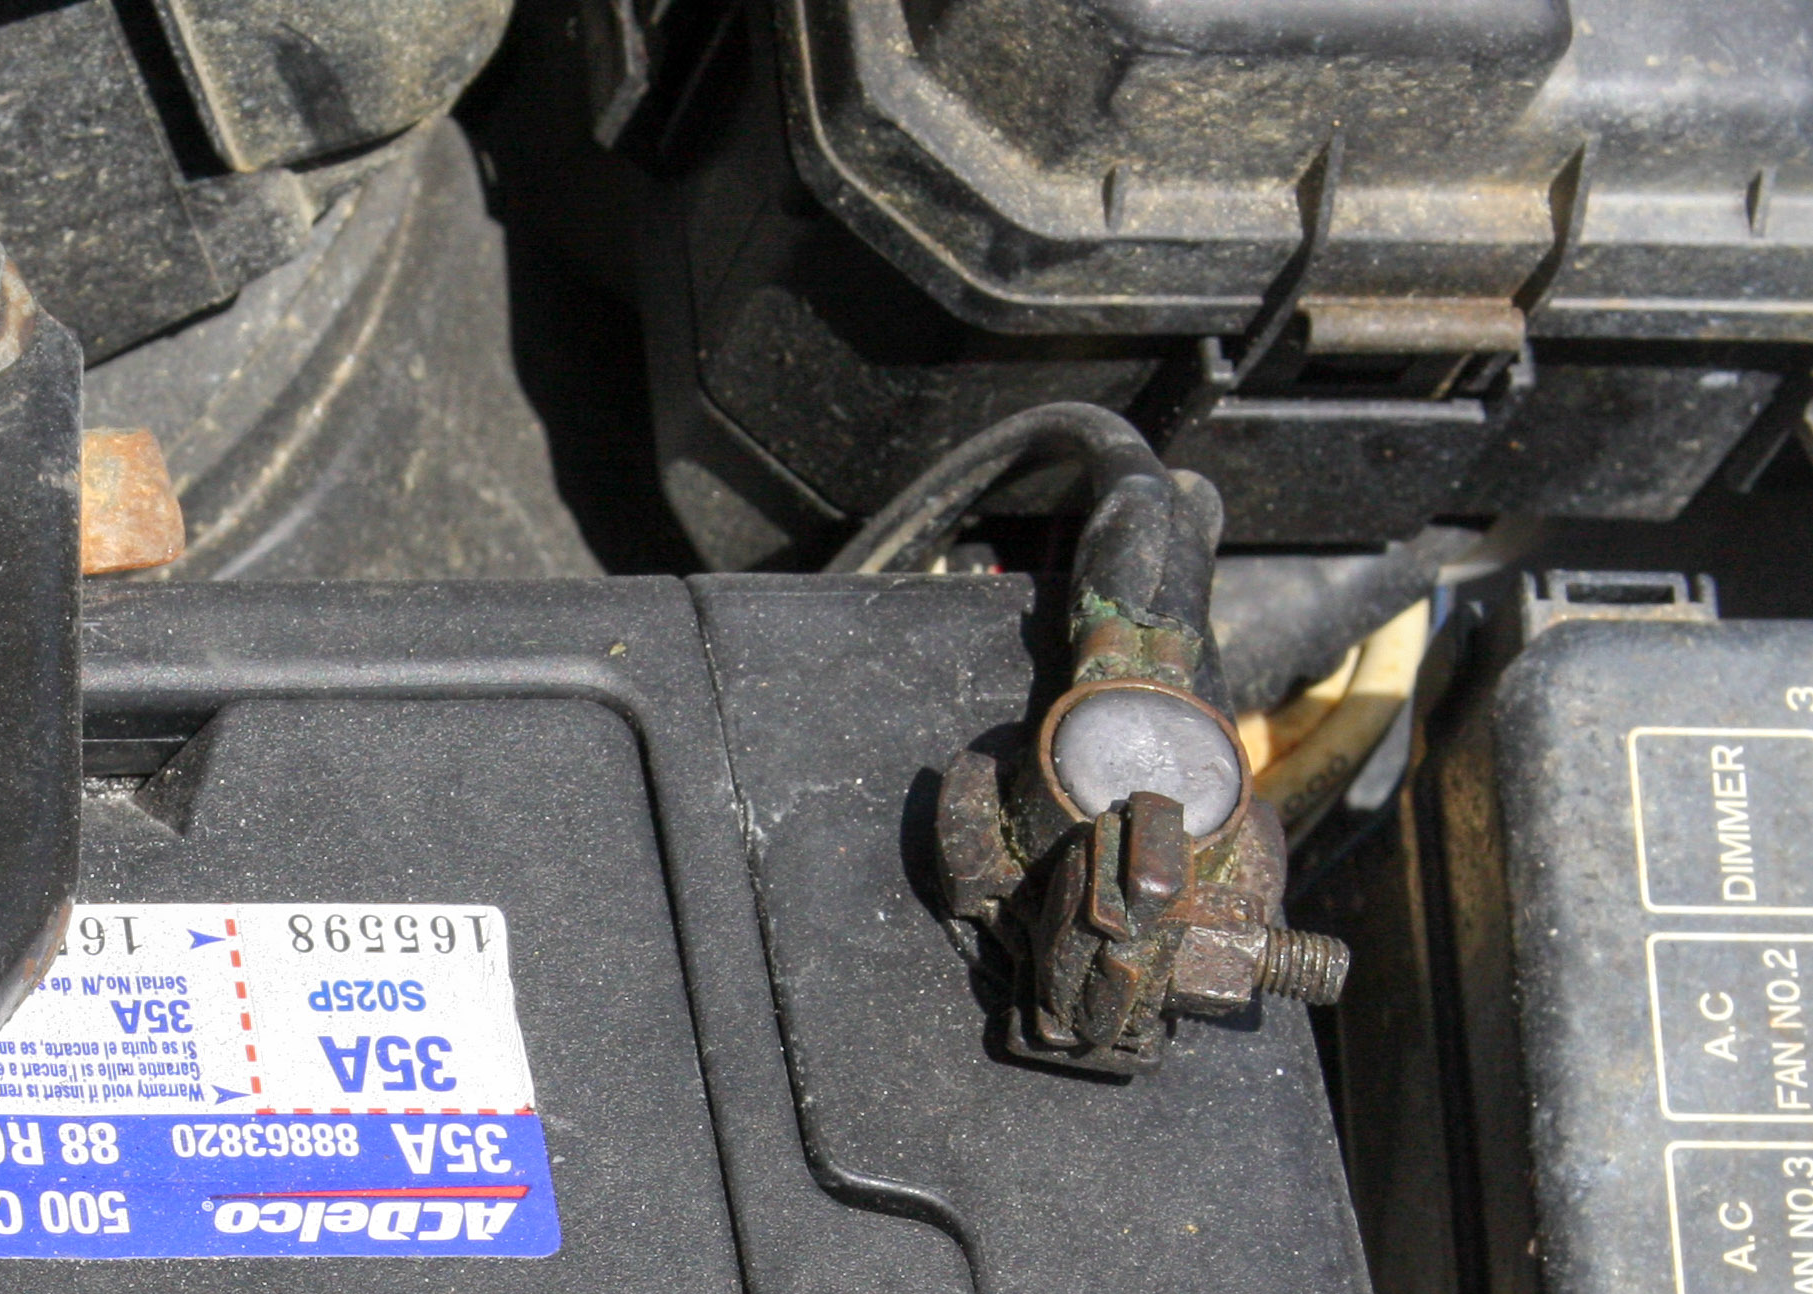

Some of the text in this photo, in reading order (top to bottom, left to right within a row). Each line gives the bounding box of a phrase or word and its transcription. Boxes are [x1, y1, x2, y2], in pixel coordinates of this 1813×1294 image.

[1711, 744, 1757, 901] DIMMER
[288, 914, 492, 953] 165598
[51, 977, 71, 994] de
[135, 976, 187, 995] Serial
[308, 980, 426, 1012] S025P
[111, 999, 193, 1034] 35A
[1699, 991, 1738, 1062] A.C
[1762, 948, 1812, 1109] FAN NO.2
[20, 1042, 36, 1056] se
[40, 1040, 100, 1058] encarte,
[104, 1042, 117, 1059] el
[122, 1037, 157, 1058] quita
[162, 1041, 178, 1055] se
[181, 1041, 197, 1058] Si
[10, 1062, 17, 1075] a
[22, 1062, 77, 1080] l'encart
[81, 1062, 93, 1080] si
[98, 1062, 134, 1080] nulle
[139, 1062, 200, 1079] Garantie
[318, 1036, 457, 1092] 35A
[27, 1085, 39, 1101] is
[43, 1085, 84, 1101] insert
[88, 1085, 98, 1102] if
[102, 1084, 133, 1101] void
[137, 1080, 204, 1101] Warranty
[57, 1122, 119, 1165] 88
[172, 1123, 512, 1175] 35A 88863820
[39, 1190, 131, 1234] 500
[1718, 1201, 1758, 1273] A.C
